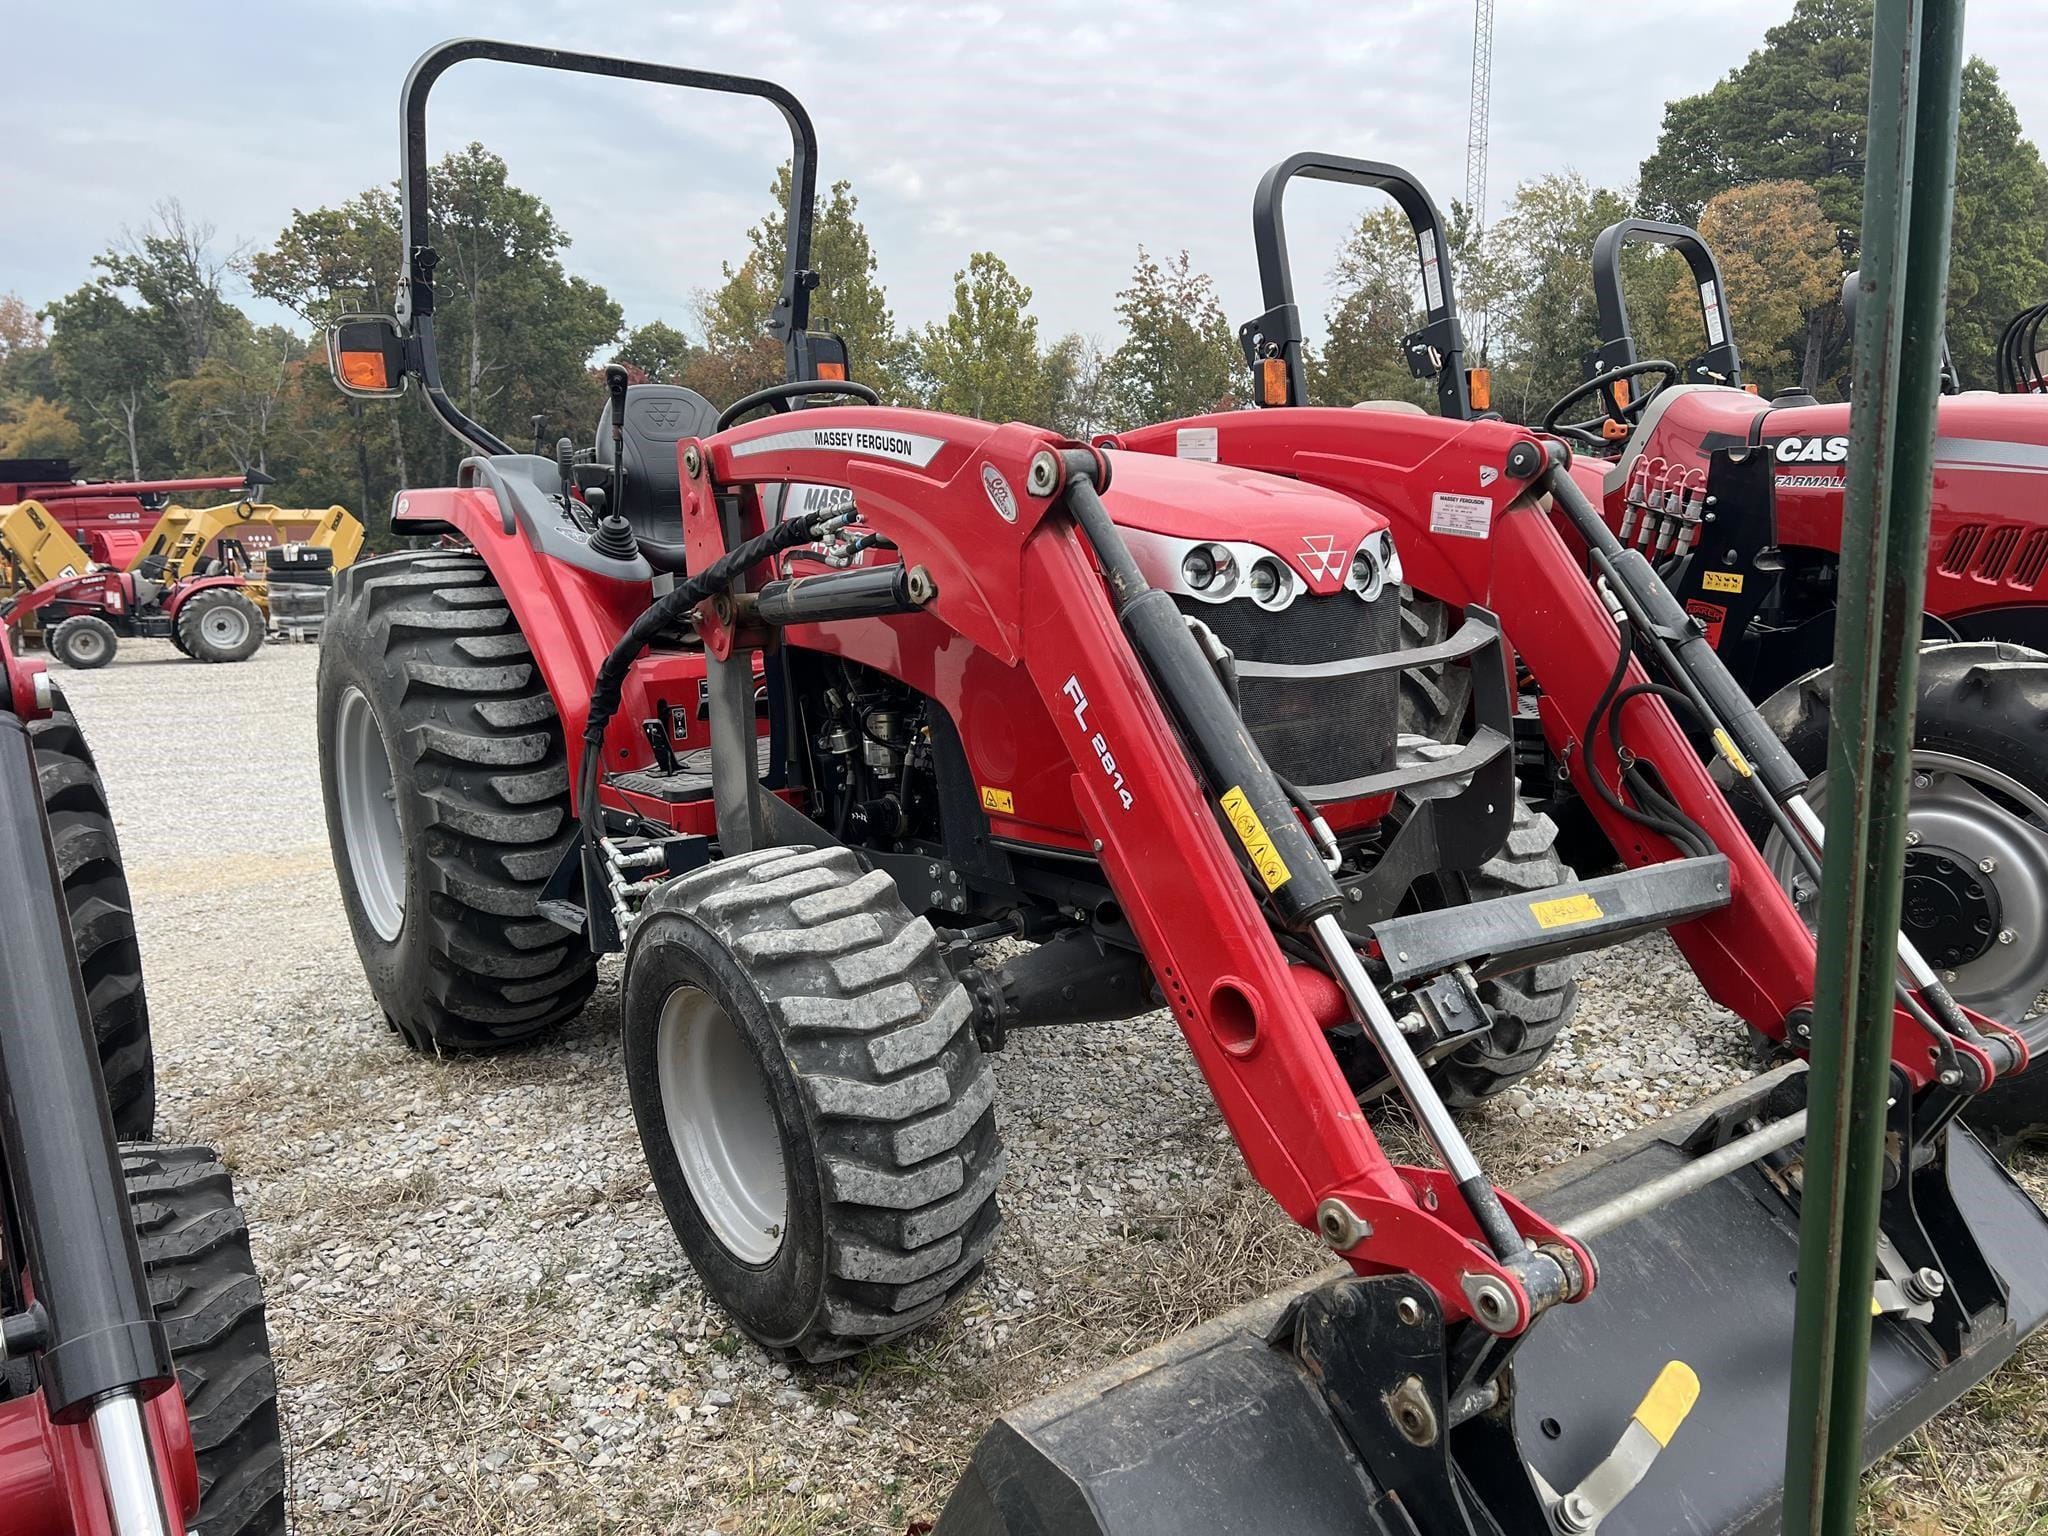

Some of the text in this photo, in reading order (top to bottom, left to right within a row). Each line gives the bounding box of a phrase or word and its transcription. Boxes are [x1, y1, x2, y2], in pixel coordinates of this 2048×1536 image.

[814, 432, 912, 456] MASSEY FERGUSON
[1775, 437, 1849, 462] CAS
[1439, 495, 1459, 503] MASSEY
[1062, 673, 1133, 811] FL 2814
